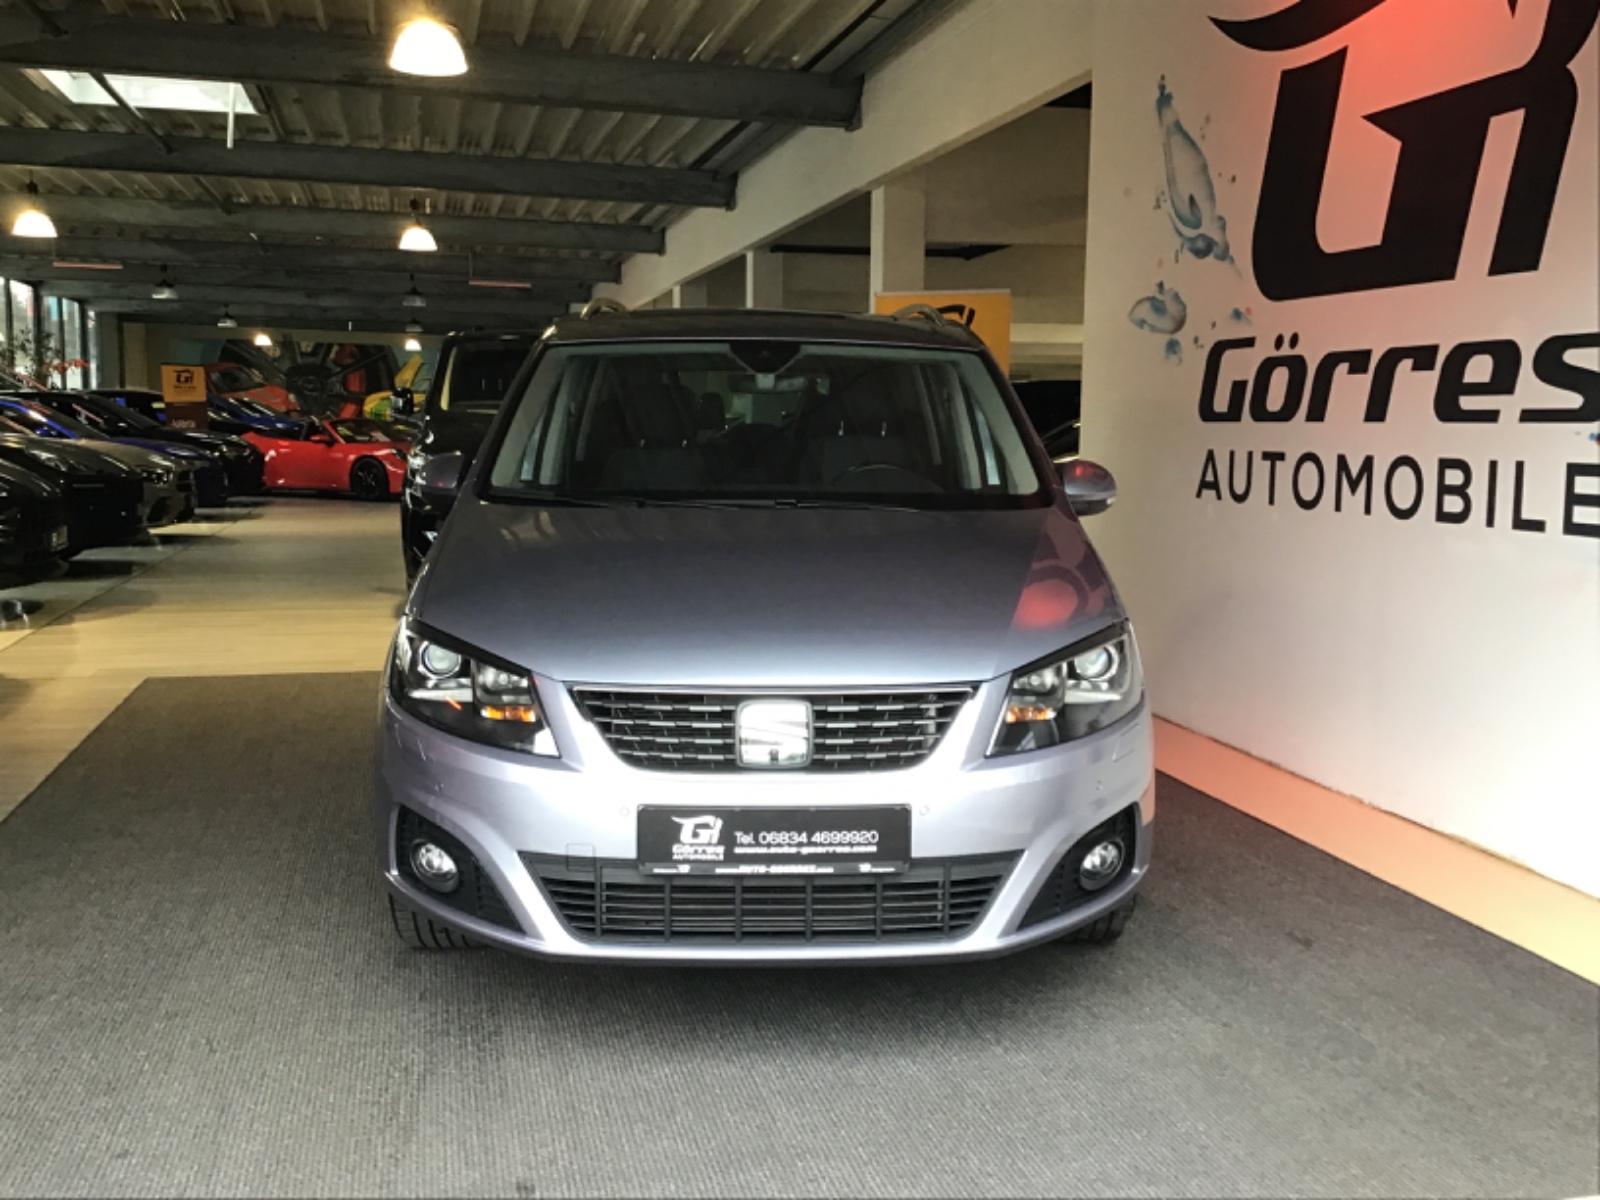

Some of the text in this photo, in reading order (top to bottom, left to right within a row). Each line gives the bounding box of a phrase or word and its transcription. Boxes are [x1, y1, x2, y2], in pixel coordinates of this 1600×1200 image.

[1198, 332, 1600, 424] Görres
[1195, 447, 1600, 539] AUTOMOBILE
[759, 831, 807, 844] 06834
[812, 830, 879, 844] 4699920
